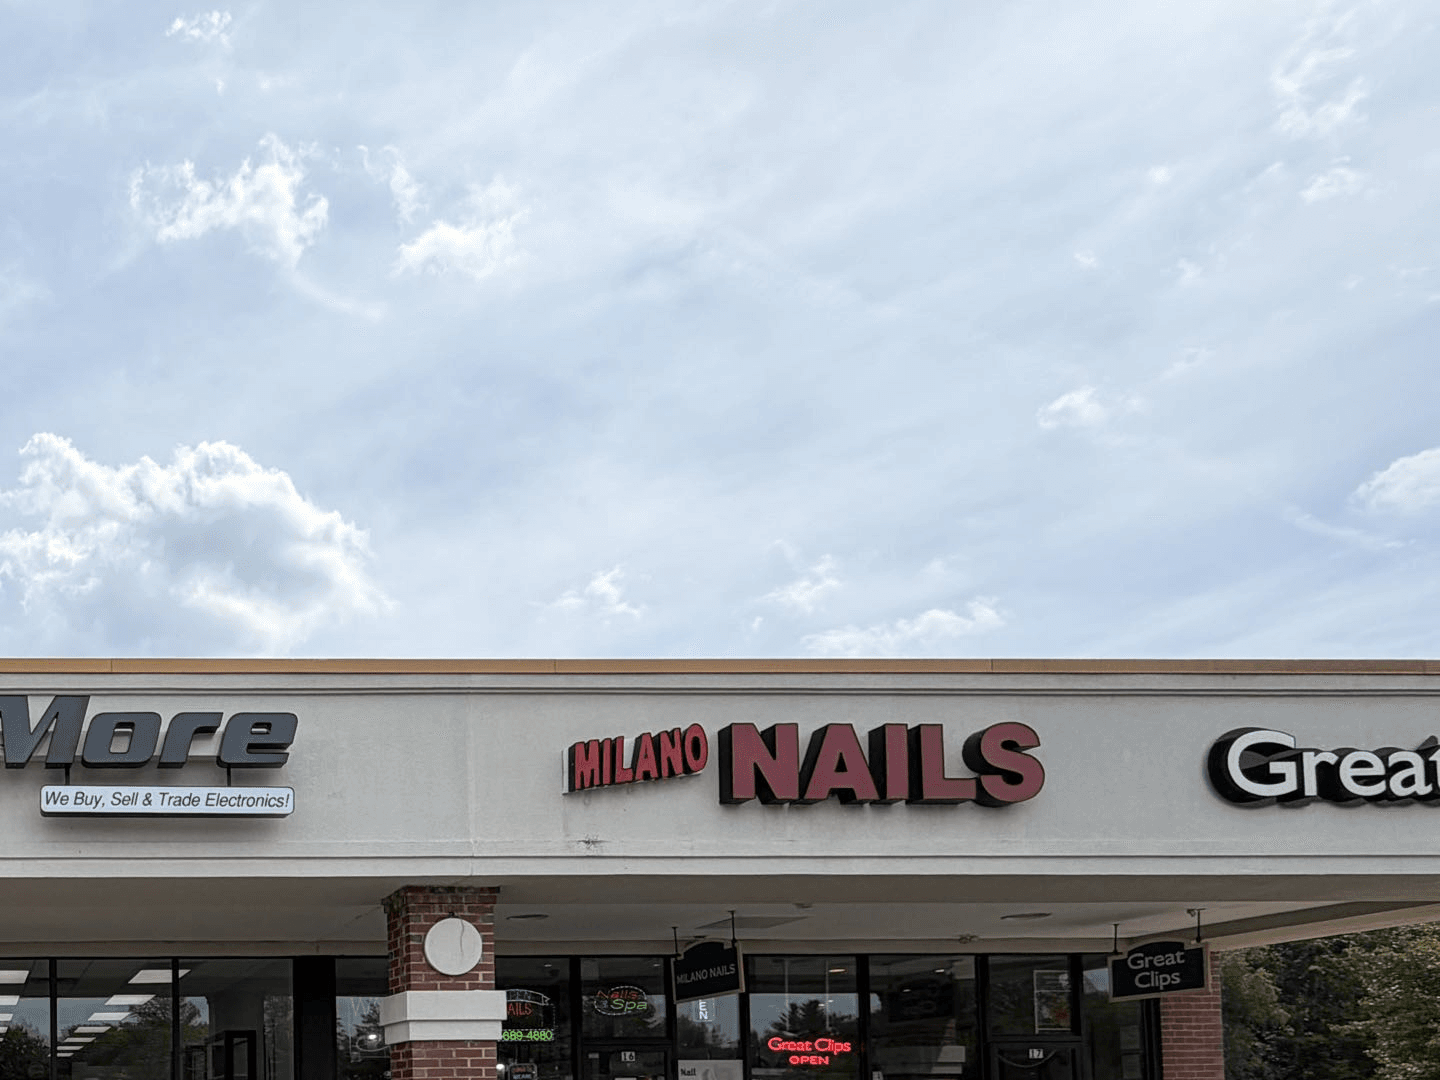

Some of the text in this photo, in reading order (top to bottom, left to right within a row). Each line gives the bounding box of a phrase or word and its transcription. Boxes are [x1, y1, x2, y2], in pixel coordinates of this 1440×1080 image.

[570, 720, 1046, 804] MILANO NAILS
[44, 791, 290, 809] We Buy, Sell & Trade Electronics!
[1127, 950, 1185, 969] Great
[676, 963, 736, 985] MILANO NAILS
[1134, 970, 1181, 990] Clips
[596, 989, 639, 1000] Nails
[507, 1002, 533, 1017] AILS
[610, 998, 648, 1011] Spa
[767, 1036, 852, 1056] Great Clips
[789, 1055, 830, 1065] OPEN
[680, 1067, 696, 1076] Nail
